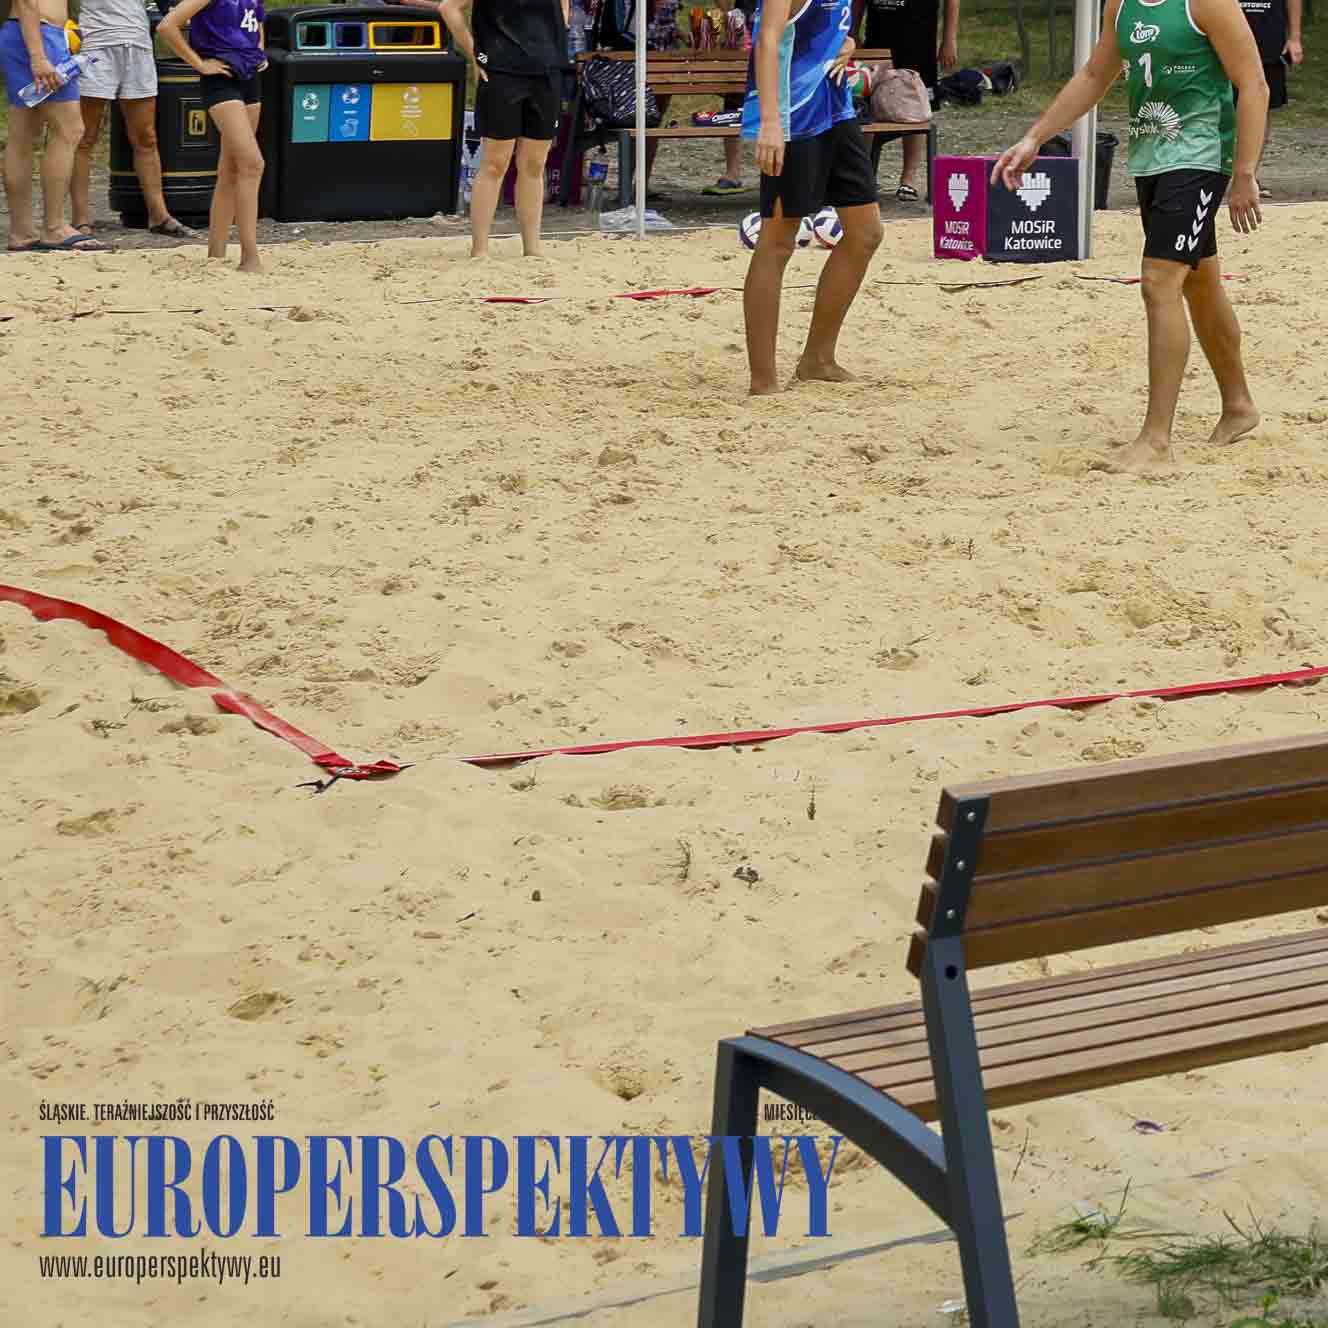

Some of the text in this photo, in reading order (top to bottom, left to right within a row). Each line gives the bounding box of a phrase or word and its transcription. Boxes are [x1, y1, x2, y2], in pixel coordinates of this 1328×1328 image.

[1138, 52, 1153, 88] 1
[944, 221, 970, 235] MOSiR
[1011, 220, 1056, 235] MOSiR
[939, 236, 974, 251] Katowice
[1004, 236, 1062, 250] Katowice
